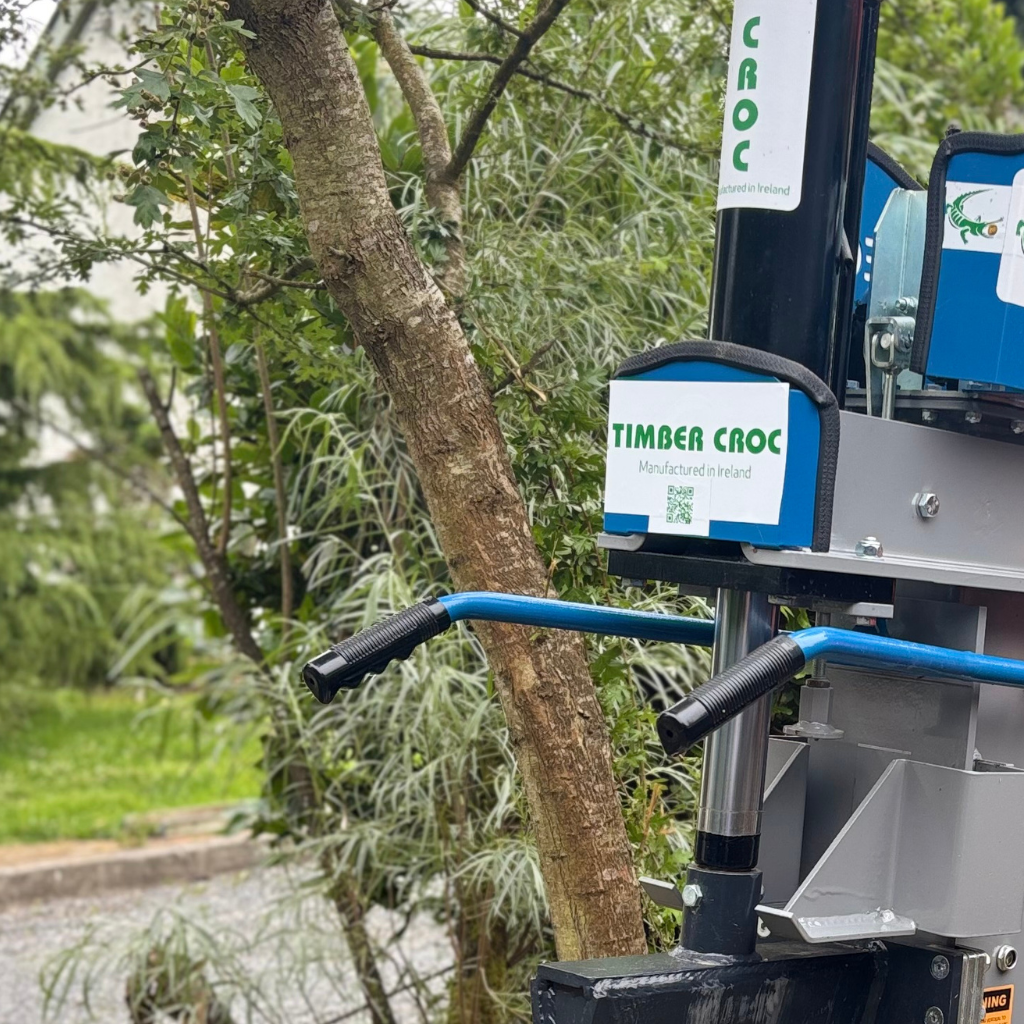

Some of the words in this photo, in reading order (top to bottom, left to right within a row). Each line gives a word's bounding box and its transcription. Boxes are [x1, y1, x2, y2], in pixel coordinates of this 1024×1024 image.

[732, 16, 761, 172] CROC
[748, 183, 756, 193] in
[758, 183, 791, 196] Ireland
[612, 423, 704, 452] TIMBER
[713, 426, 782, 455] CROC
[638, 460, 706, 477] Manufactured
[707, 464, 716, 478] in
[718, 464, 752, 480] Ireland
[982, 994, 1007, 1009] NING
